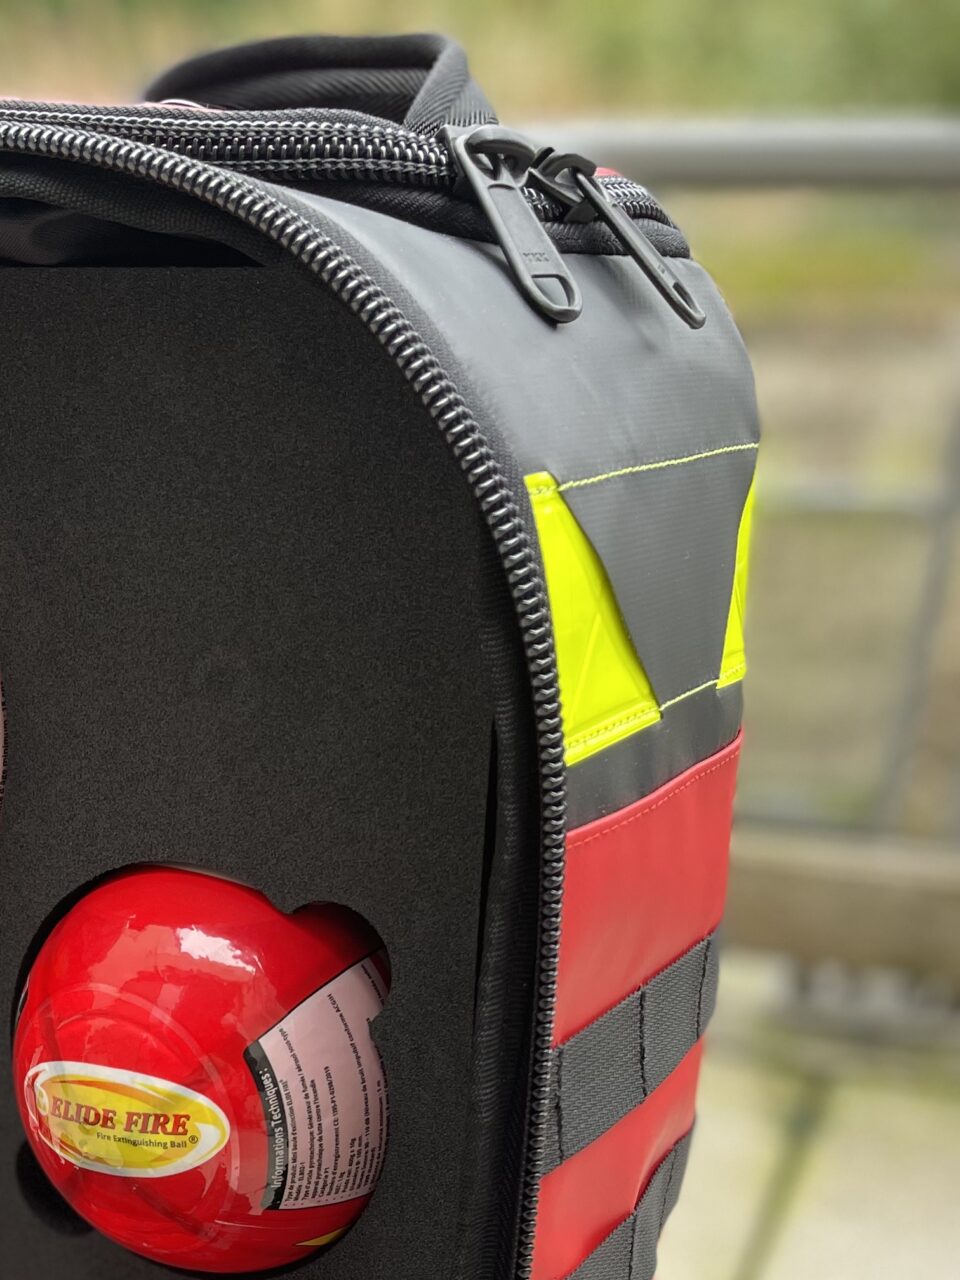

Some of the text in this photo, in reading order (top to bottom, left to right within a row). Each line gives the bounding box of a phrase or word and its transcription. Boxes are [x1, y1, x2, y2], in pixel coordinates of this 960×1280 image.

[326, 993, 341, 1013] ACGIH
[284, 1092, 293, 1106] ELIDE
[50, 1096, 191, 1136] ELIDE FIRE
[96, 1131, 112, 1143] Fire
[113, 1134, 168, 1150] Extinguishing
[169, 1140, 187, 1149] Ball
[261, 1073, 284, 1188] Informations Techniques
